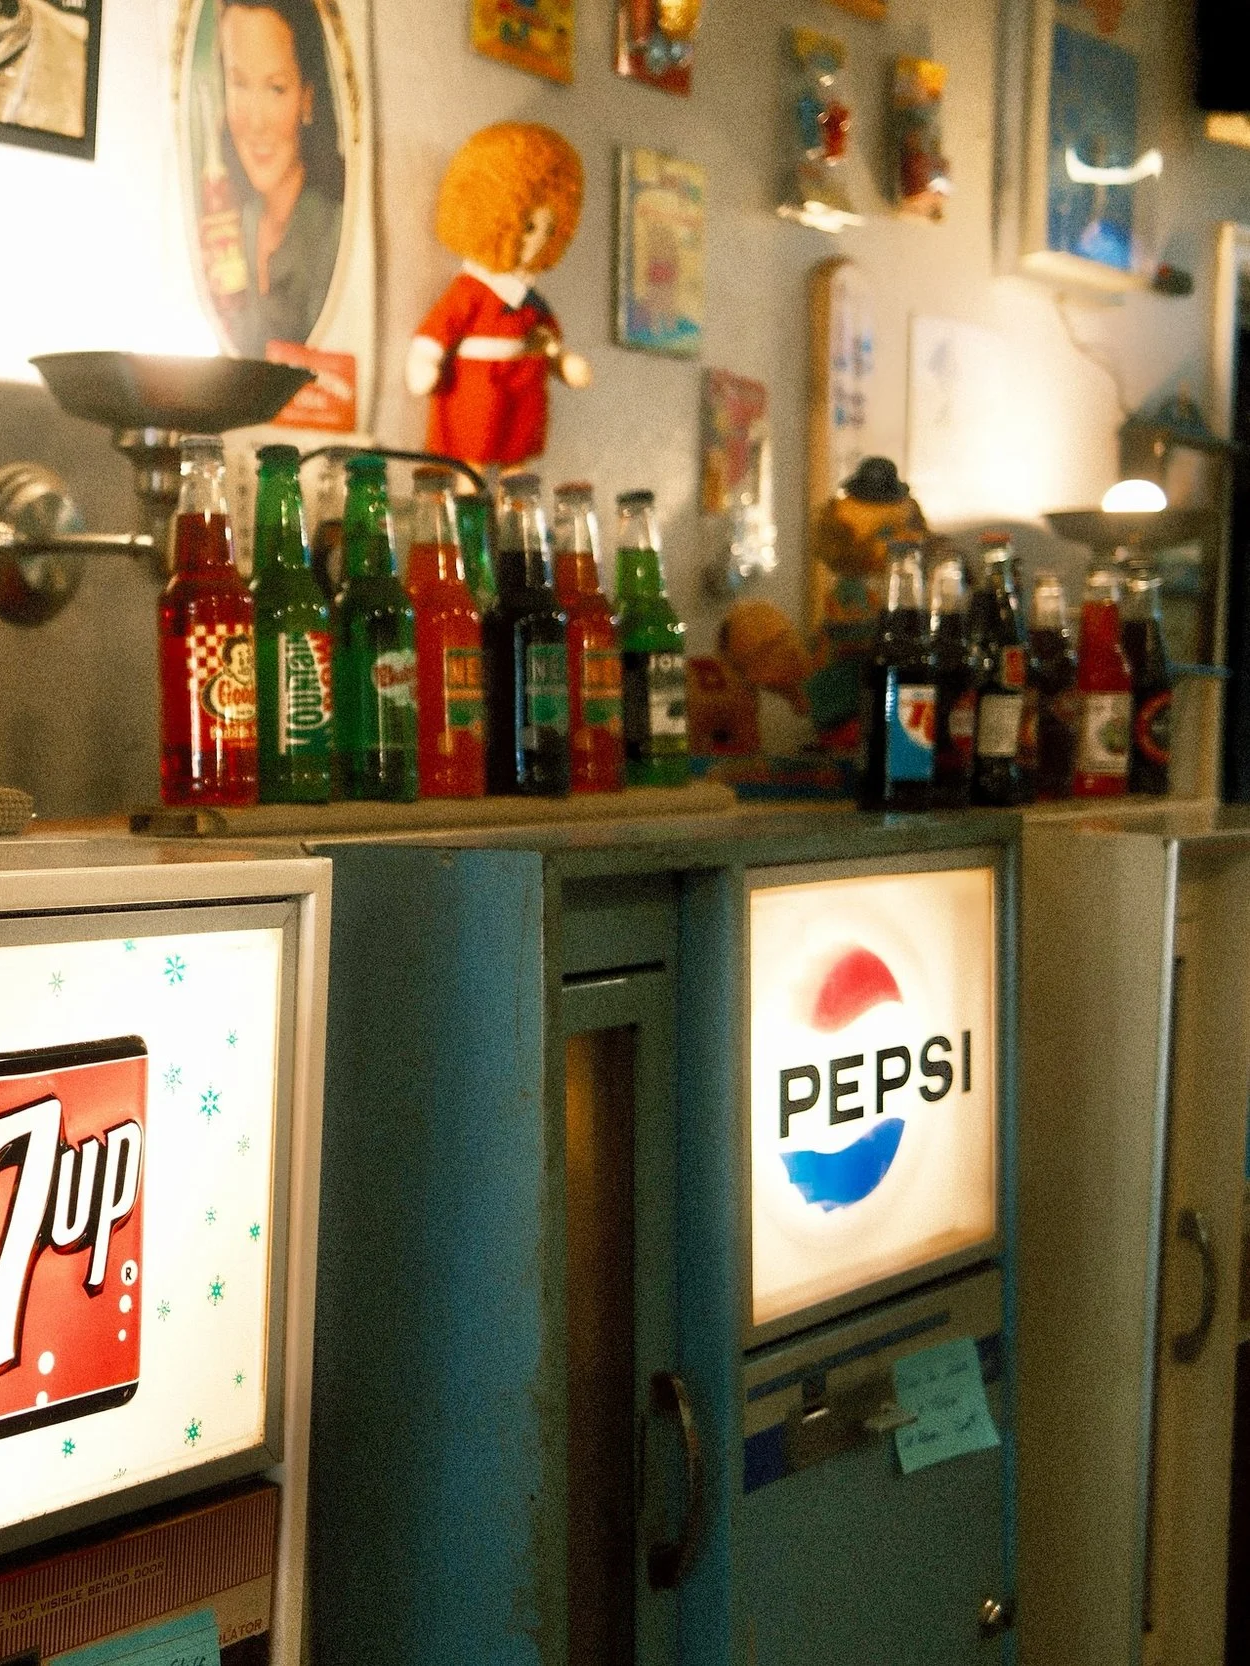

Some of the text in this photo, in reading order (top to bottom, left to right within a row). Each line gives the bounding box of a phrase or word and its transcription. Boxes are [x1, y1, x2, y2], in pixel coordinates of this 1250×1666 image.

[779, 1028, 973, 1139] PEPSI
[10, 1605, 35, 1622] NOT
[41, 1590, 83, 1612] VISIBLE
[88, 1572, 130, 1597] BEHIND
[134, 1560, 167, 1581] DOOR
[219, 1618, 263, 1645] LATOR
